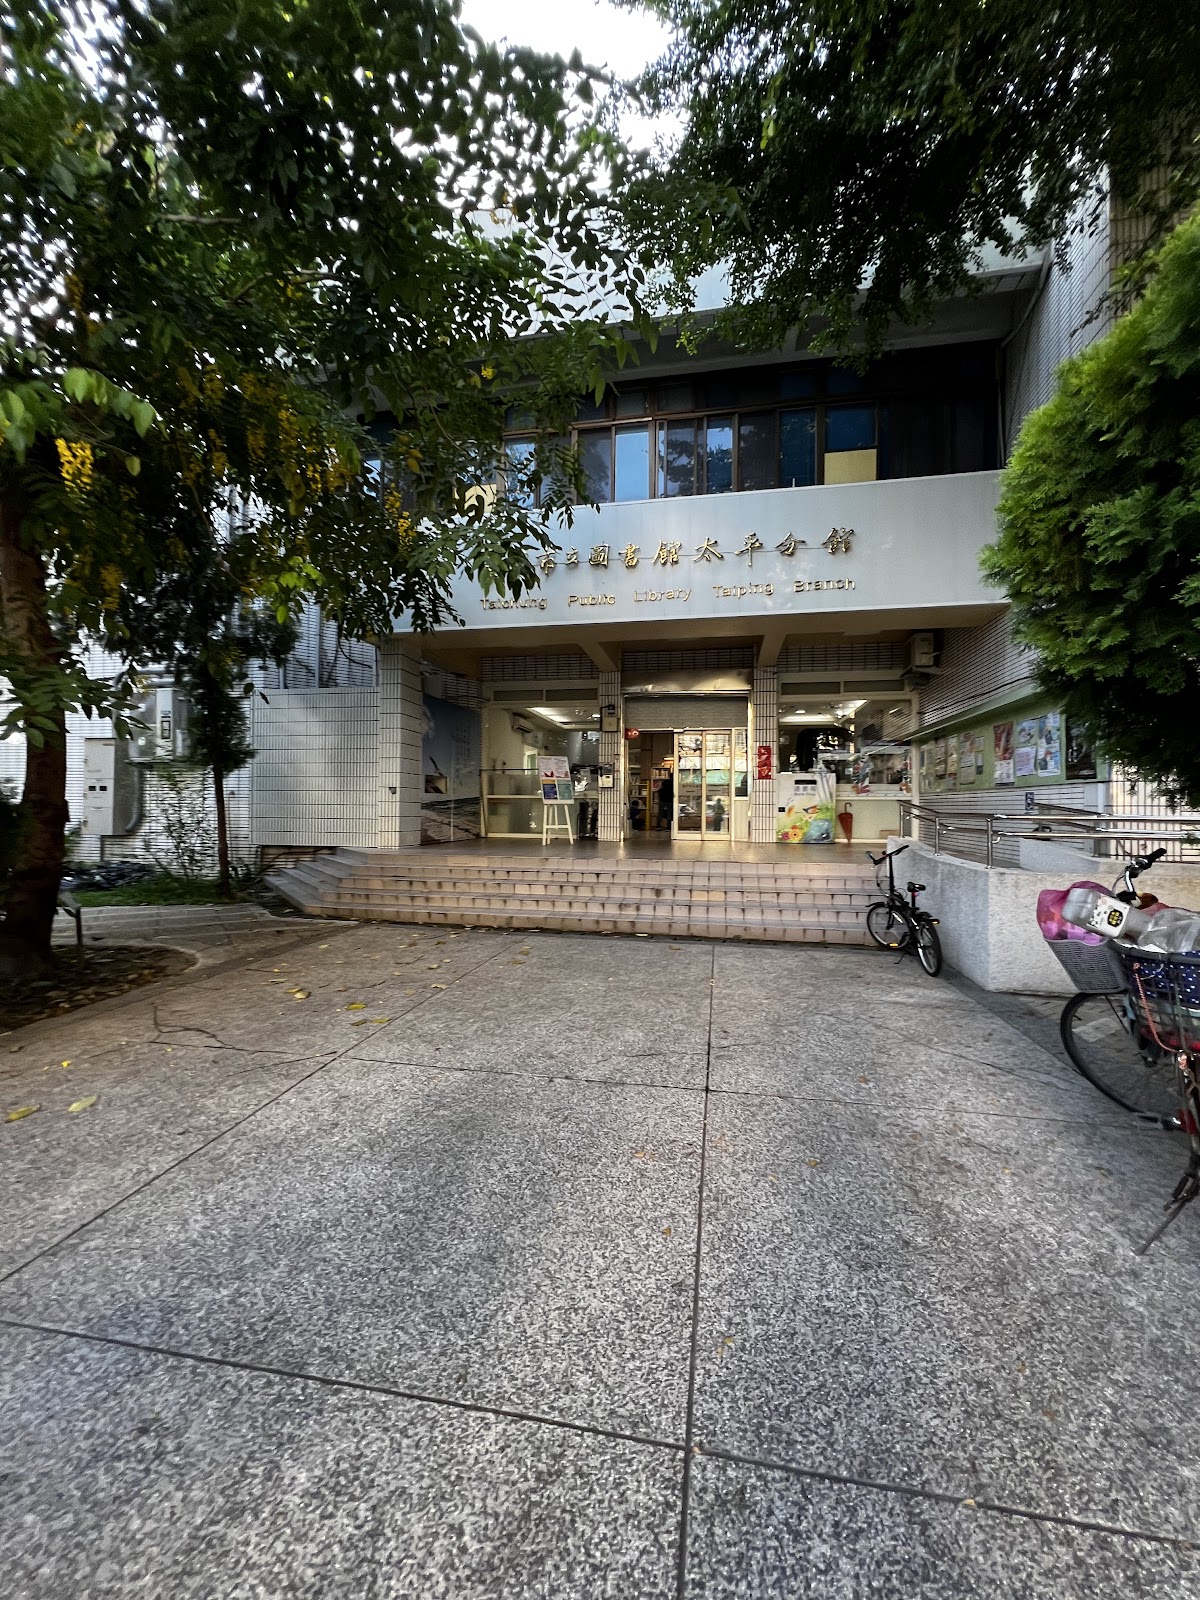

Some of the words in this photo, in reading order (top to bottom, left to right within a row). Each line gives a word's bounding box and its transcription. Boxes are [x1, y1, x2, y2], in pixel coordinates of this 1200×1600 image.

[480, 597, 548, 610] Taichung
[567, 593, 617, 607] Public
[633, 588, 693, 602] Library
[712, 582, 775, 598] Taiping
[793, 577, 856, 593] Branch
